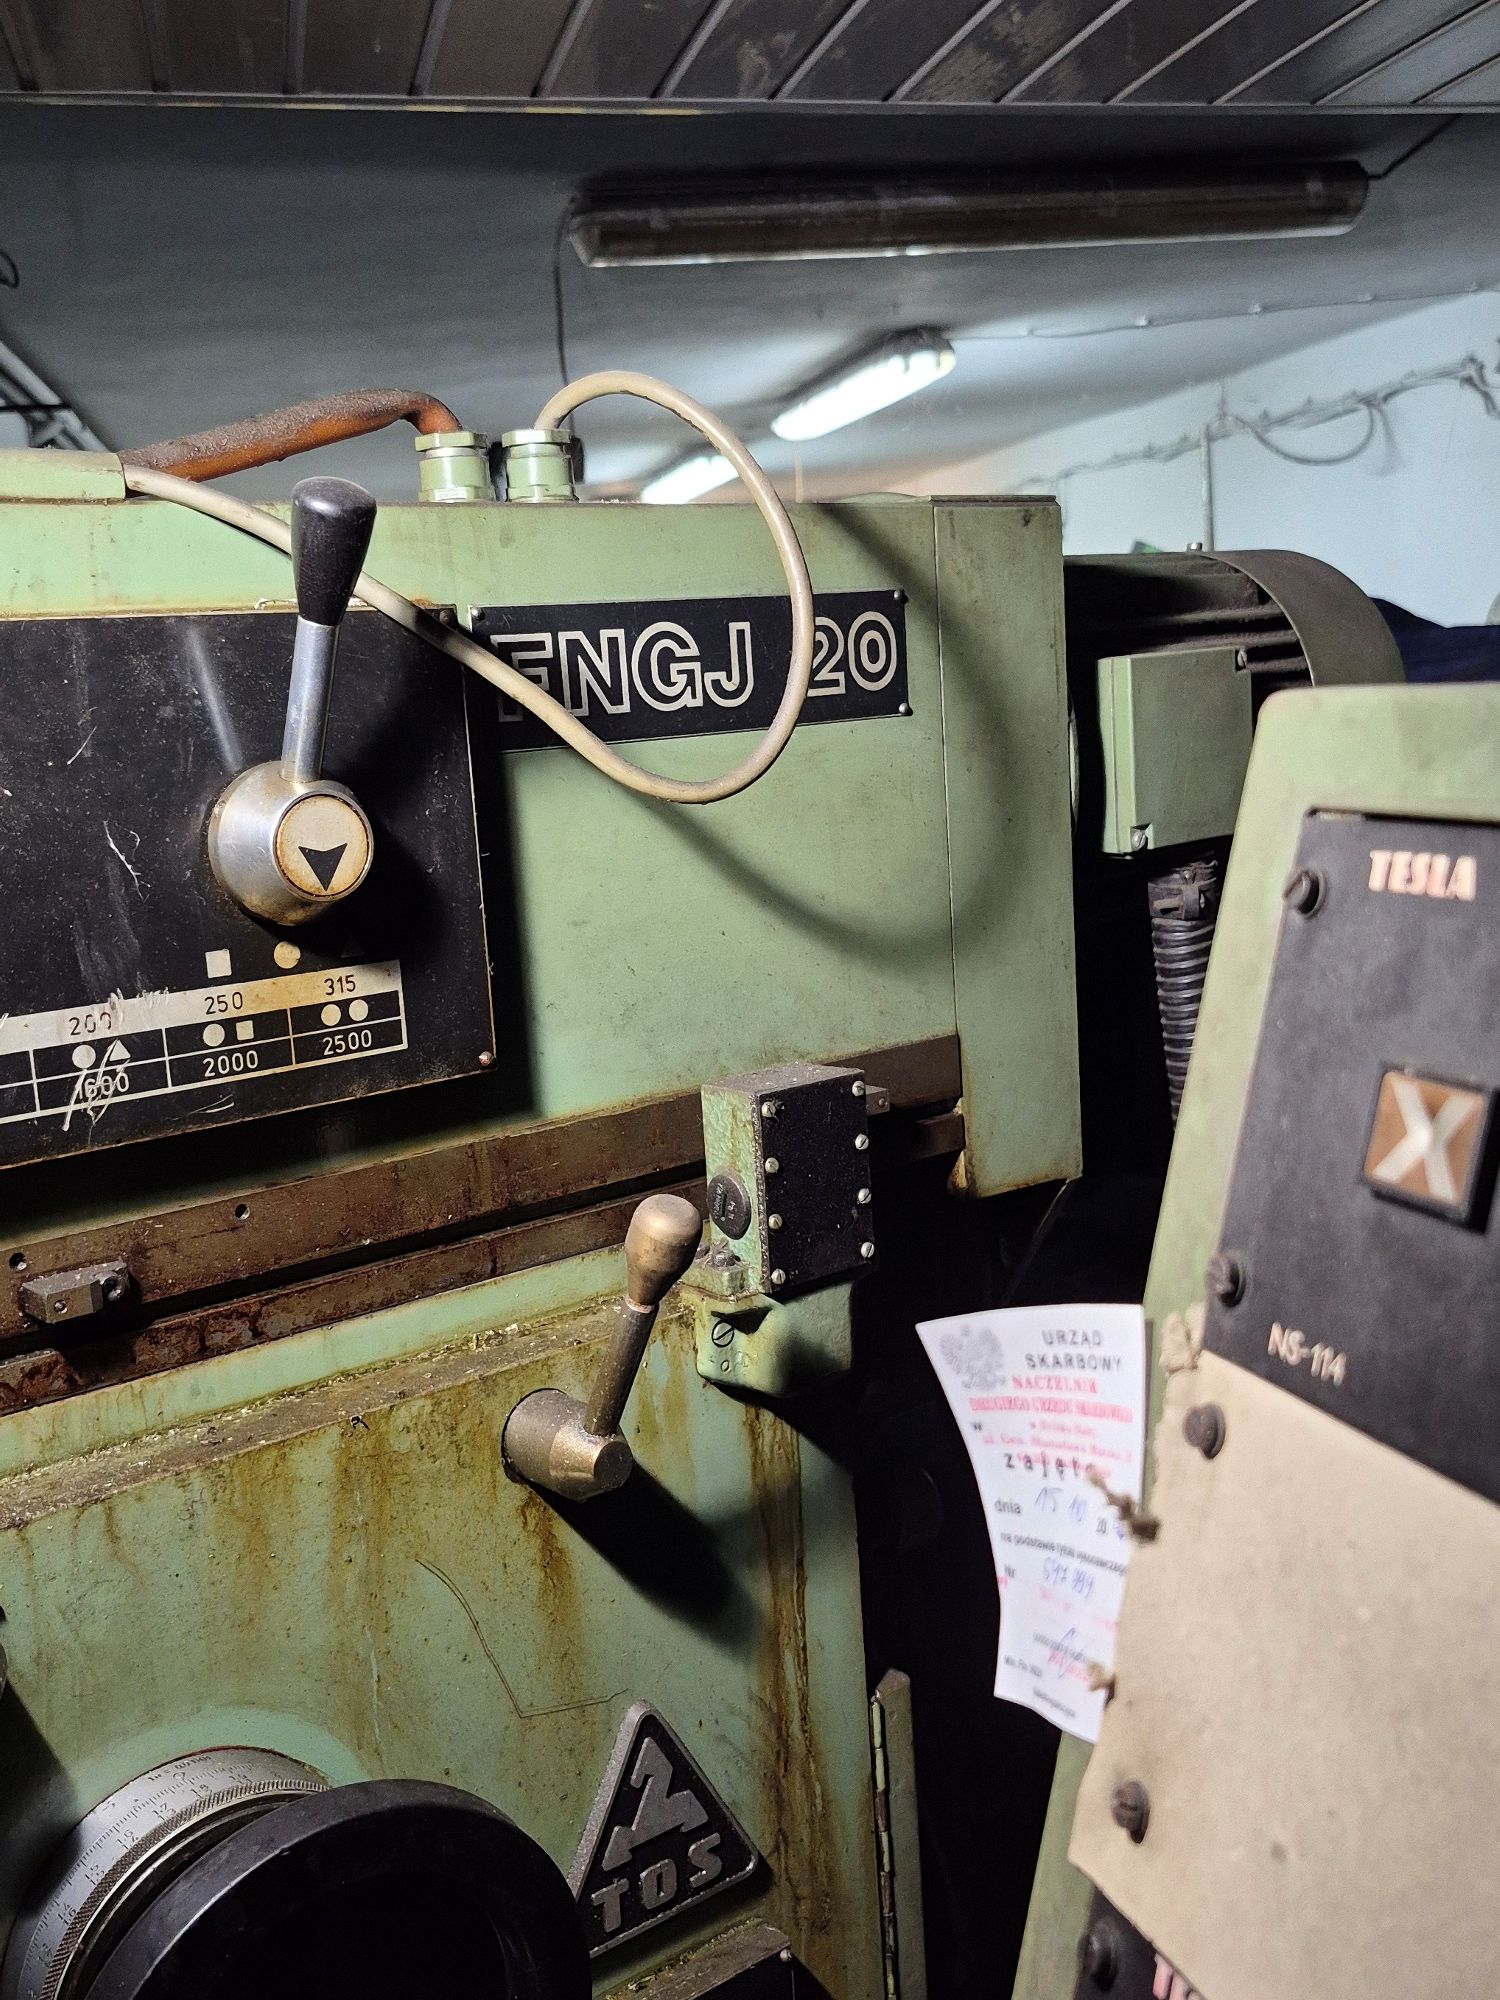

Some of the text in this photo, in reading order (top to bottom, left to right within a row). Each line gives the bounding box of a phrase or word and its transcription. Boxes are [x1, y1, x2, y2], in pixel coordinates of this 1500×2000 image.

[807, 611, 897, 697] 20
[1368, 849, 1477, 900] TESLA
[204, 991, 243, 1015] 250
[324, 974, 356, 996] 315
[203, 1050, 259, 1077] 2000
[322, 1029, 372, 1056] 2500
[1025, 1353, 1121, 1372] SKARBOWY
[1267, 1321, 1347, 1386] NS-114
[995, 1498, 1021, 1514] dnia
[591, 1832, 723, 1933] TOS
